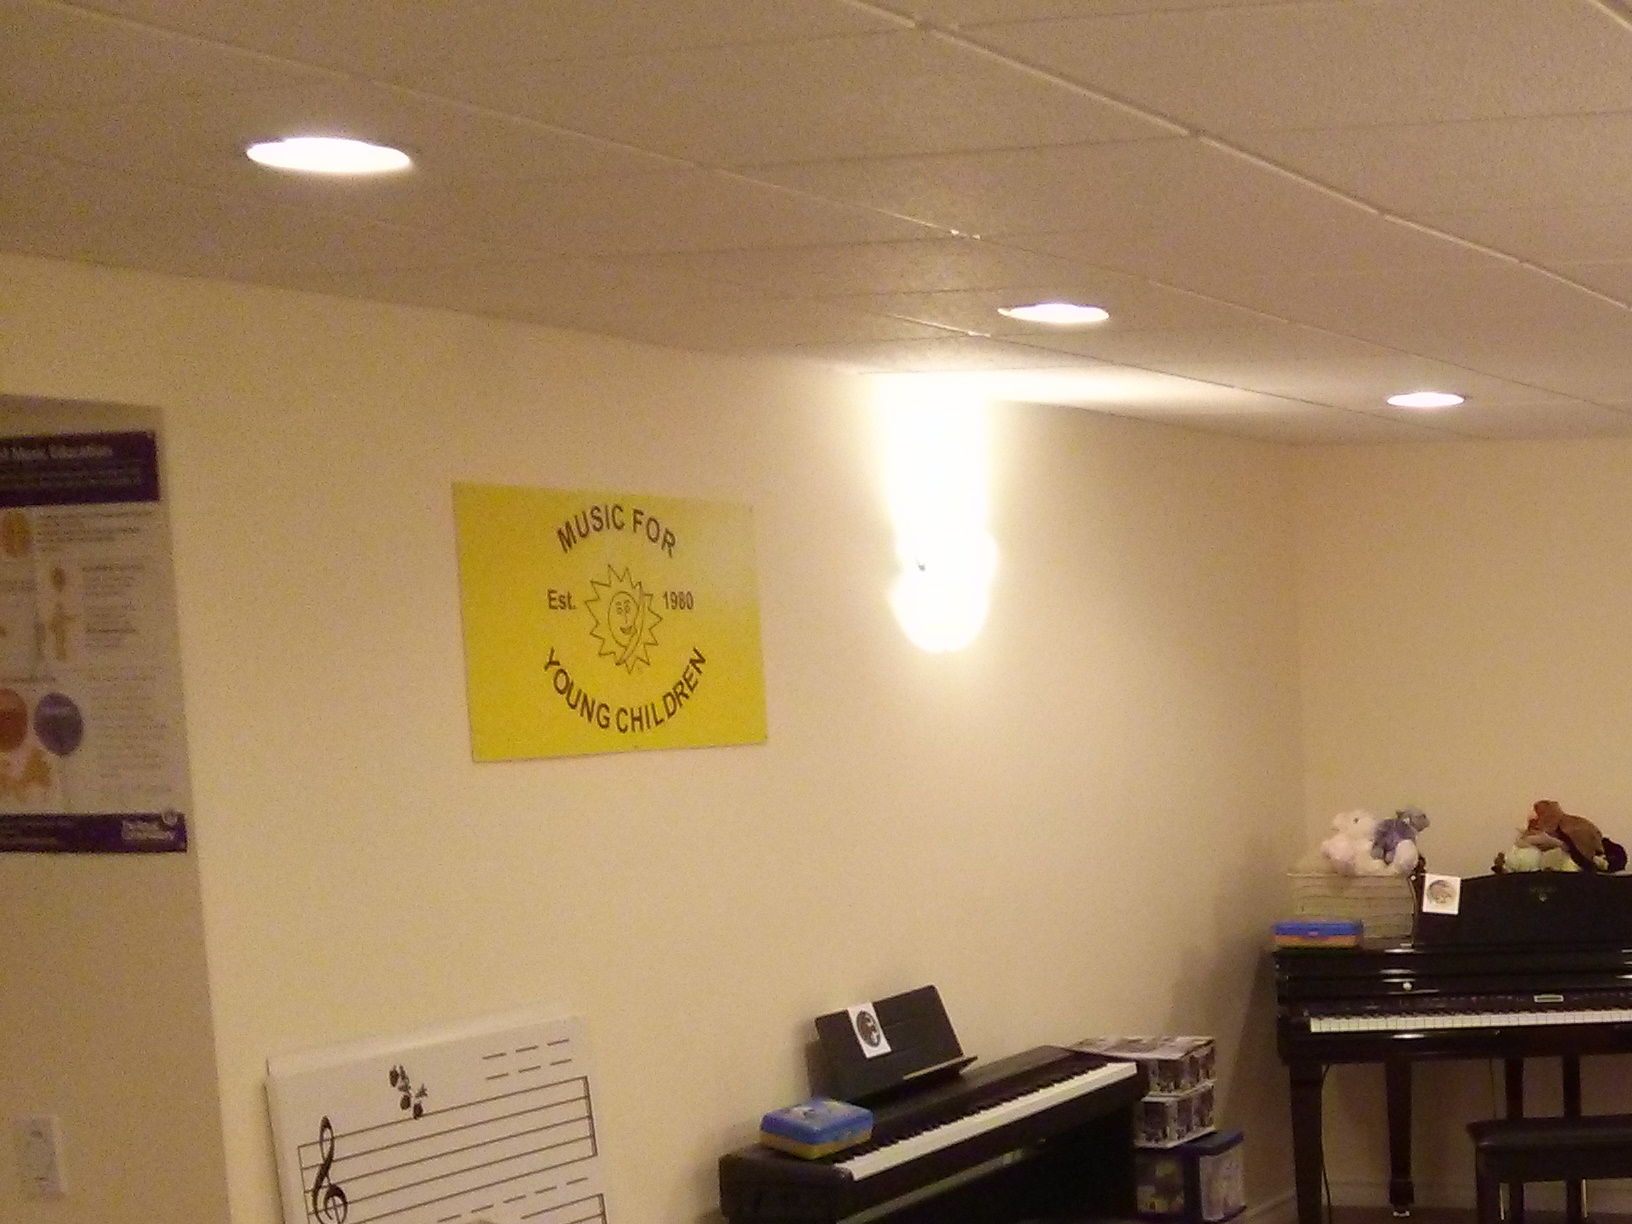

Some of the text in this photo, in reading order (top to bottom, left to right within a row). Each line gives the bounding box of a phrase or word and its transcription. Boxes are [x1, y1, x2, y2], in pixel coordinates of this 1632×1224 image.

[556, 504, 676, 559] MUSIC FOR
[547, 588, 694, 610] Est. 1980
[544, 647, 707, 734] YOUNG CHILDREN
